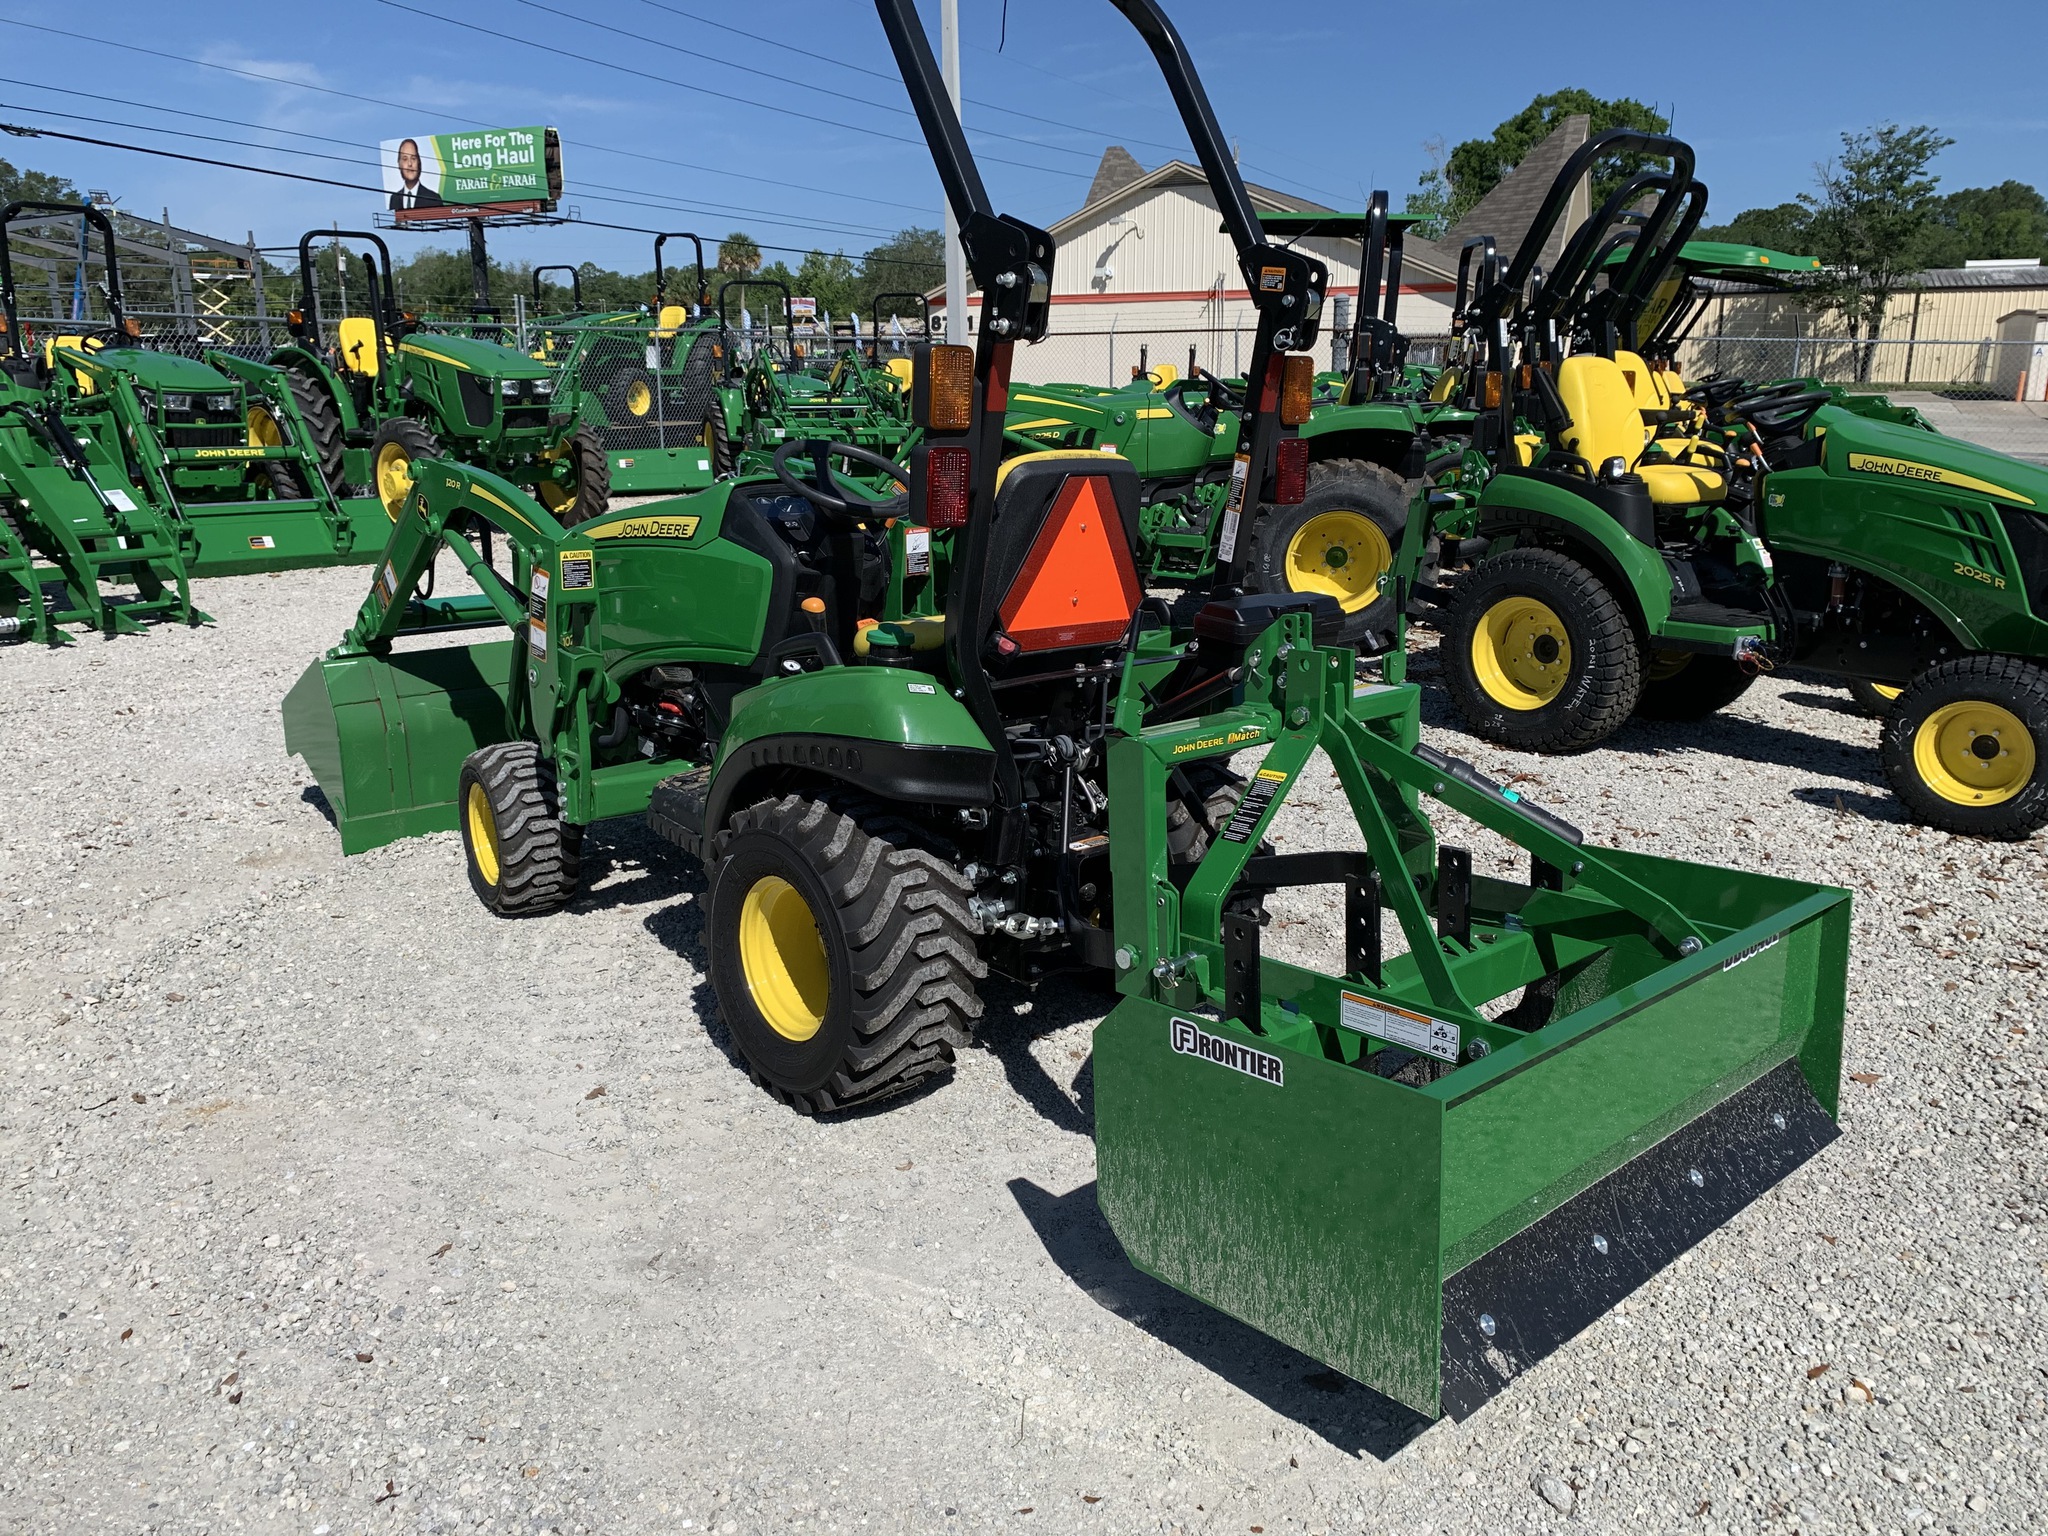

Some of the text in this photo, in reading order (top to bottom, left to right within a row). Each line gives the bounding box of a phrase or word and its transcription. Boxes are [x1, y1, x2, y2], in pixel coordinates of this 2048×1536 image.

[451, 131, 534, 151] Here For The
[453, 145, 535, 170] Long Haul
[455, 172, 537, 191] FARAH & FARAH
[1052, 431, 1060, 439] D
[195, 448, 266, 458] JOHN DEERE
[1857, 458, 1943, 481] JOHN DEERE
[618, 521, 690, 537] JOHN DEERE
[569, 551, 591, 559] CAUTION
[1953, 562, 2006, 590] 2025 R
[1563, 674, 1593, 711] WATER
[1172, 743, 1195, 755] JOHN
[1196, 737, 1224, 750] DEERE
[1172, 1018, 1282, 1084] FRONTIER
